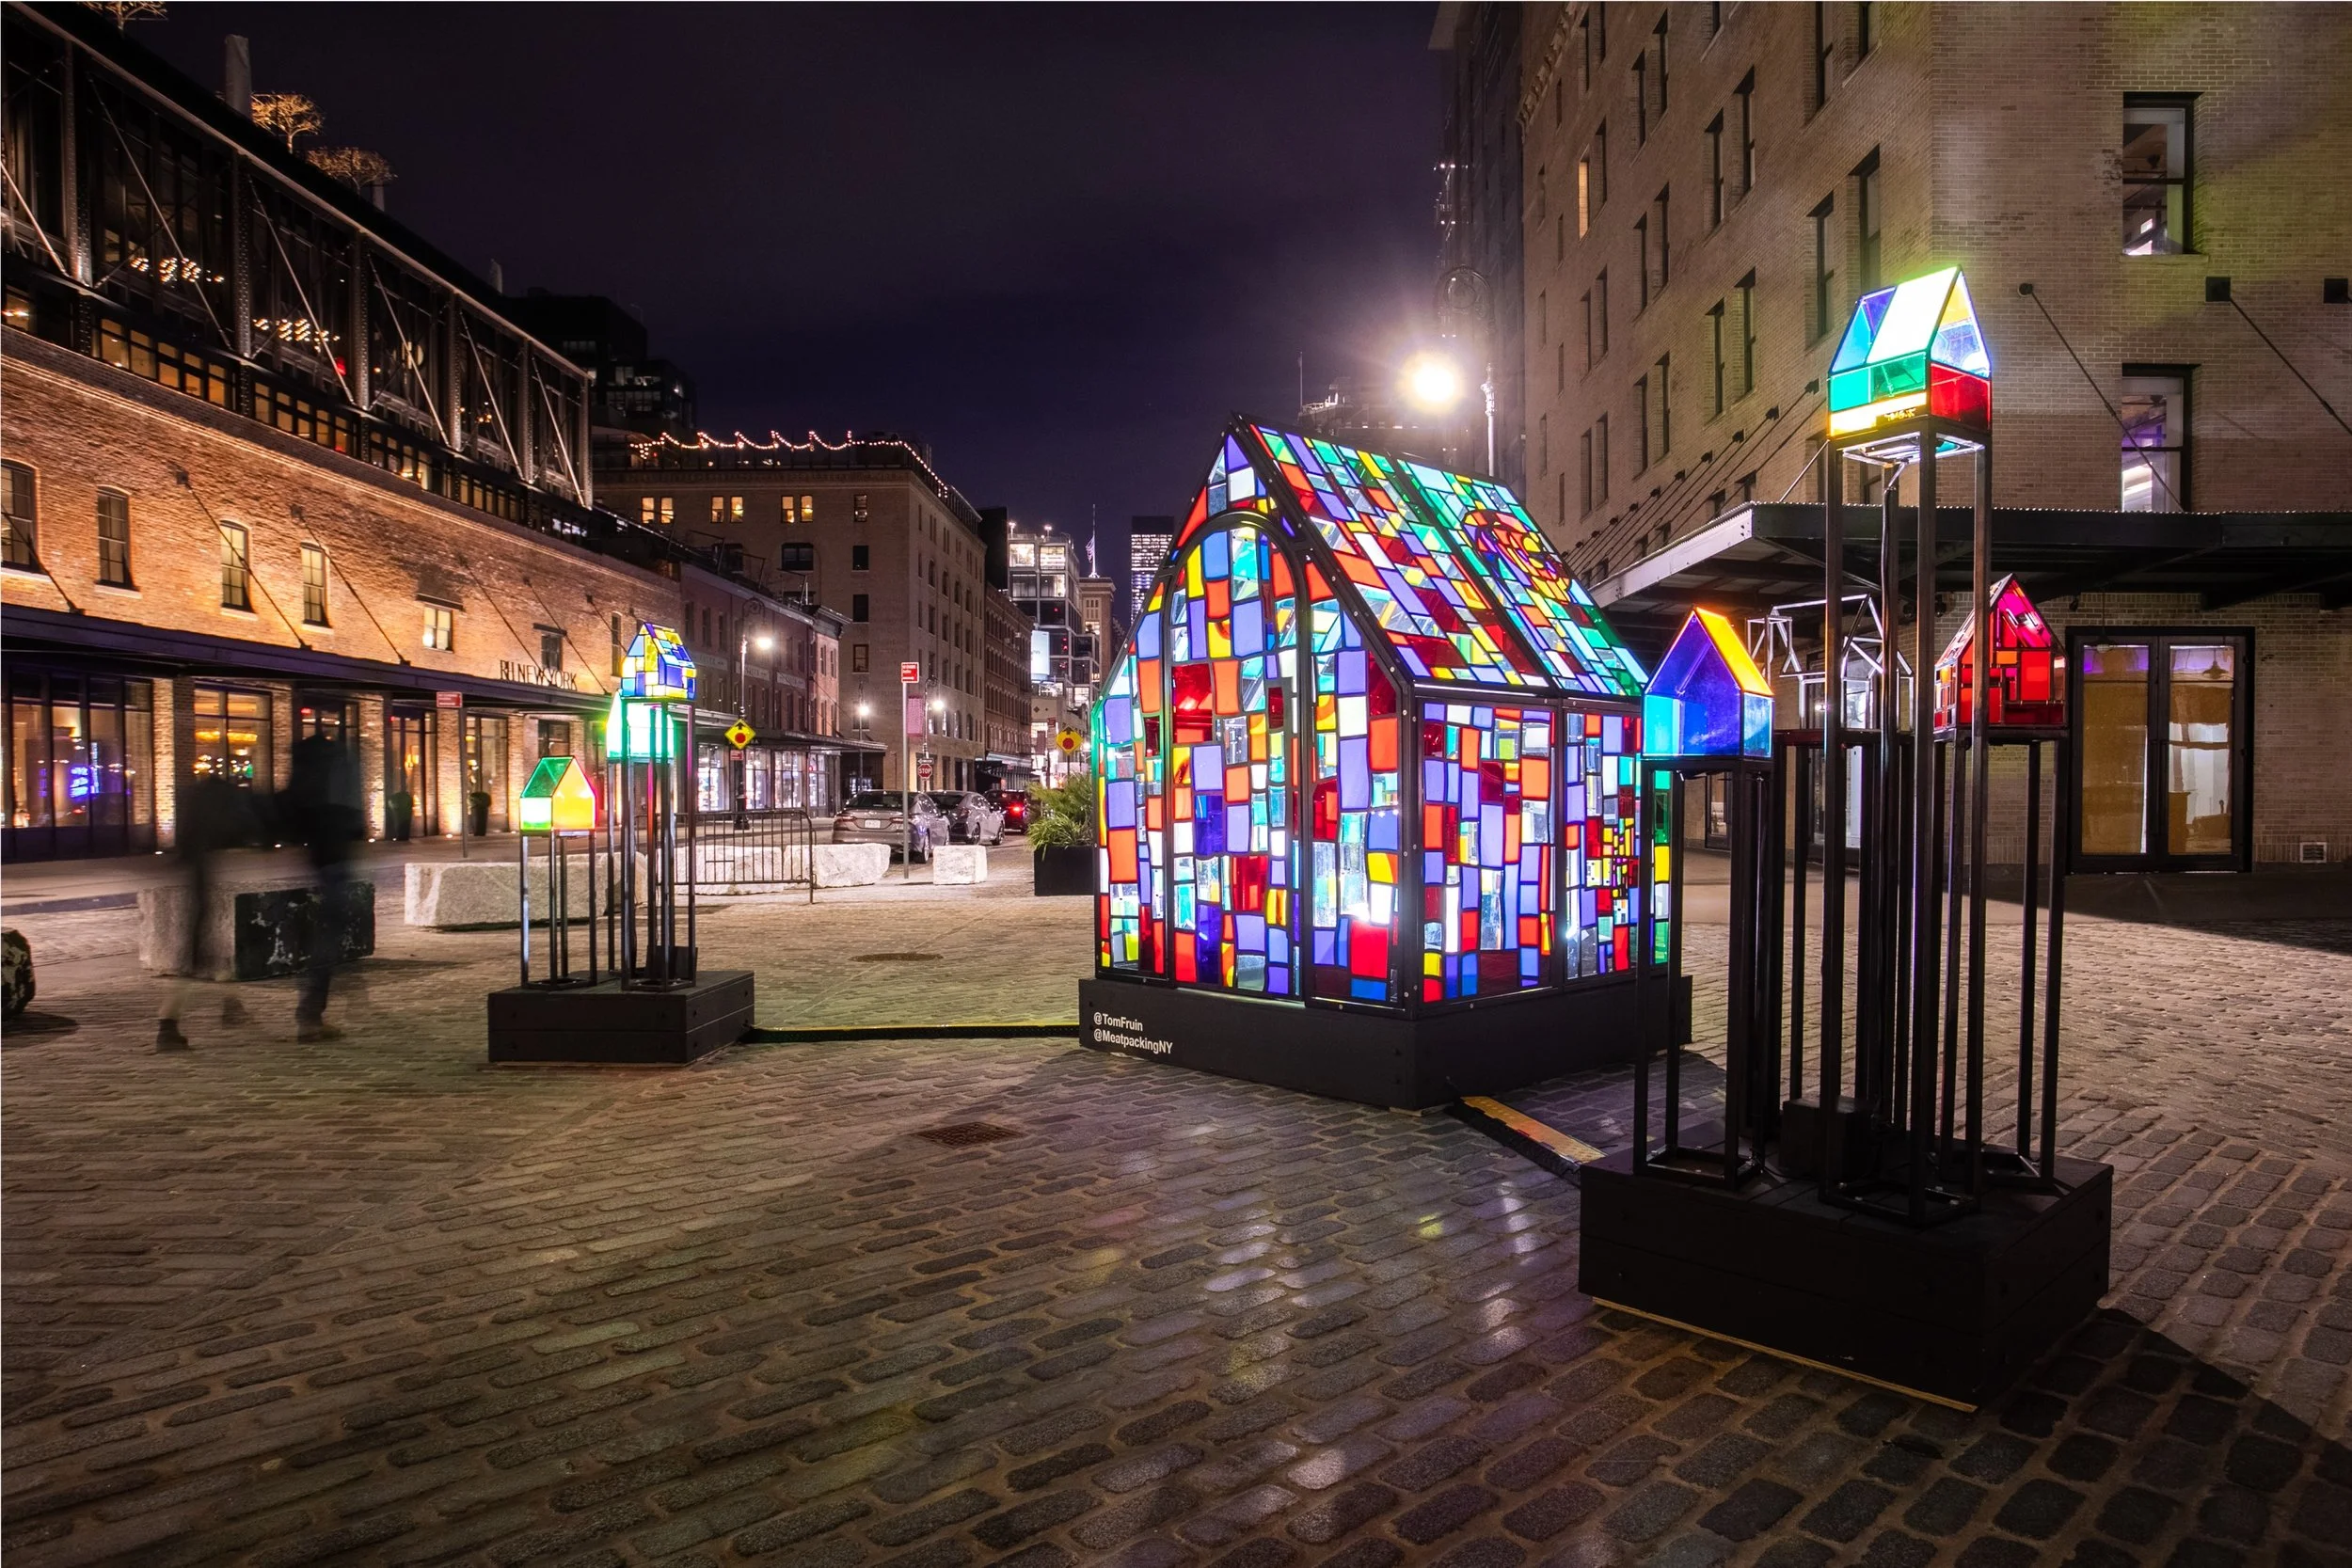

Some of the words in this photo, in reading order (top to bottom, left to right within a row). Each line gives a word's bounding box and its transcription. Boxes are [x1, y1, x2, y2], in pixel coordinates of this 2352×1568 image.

[517, 663, 546, 686] NEW
[548, 669, 578, 691] YORK
[1093, 1012, 1143, 1031] @TomFruin
[1093, 1029, 1173, 1054] @MeatpackingNY
